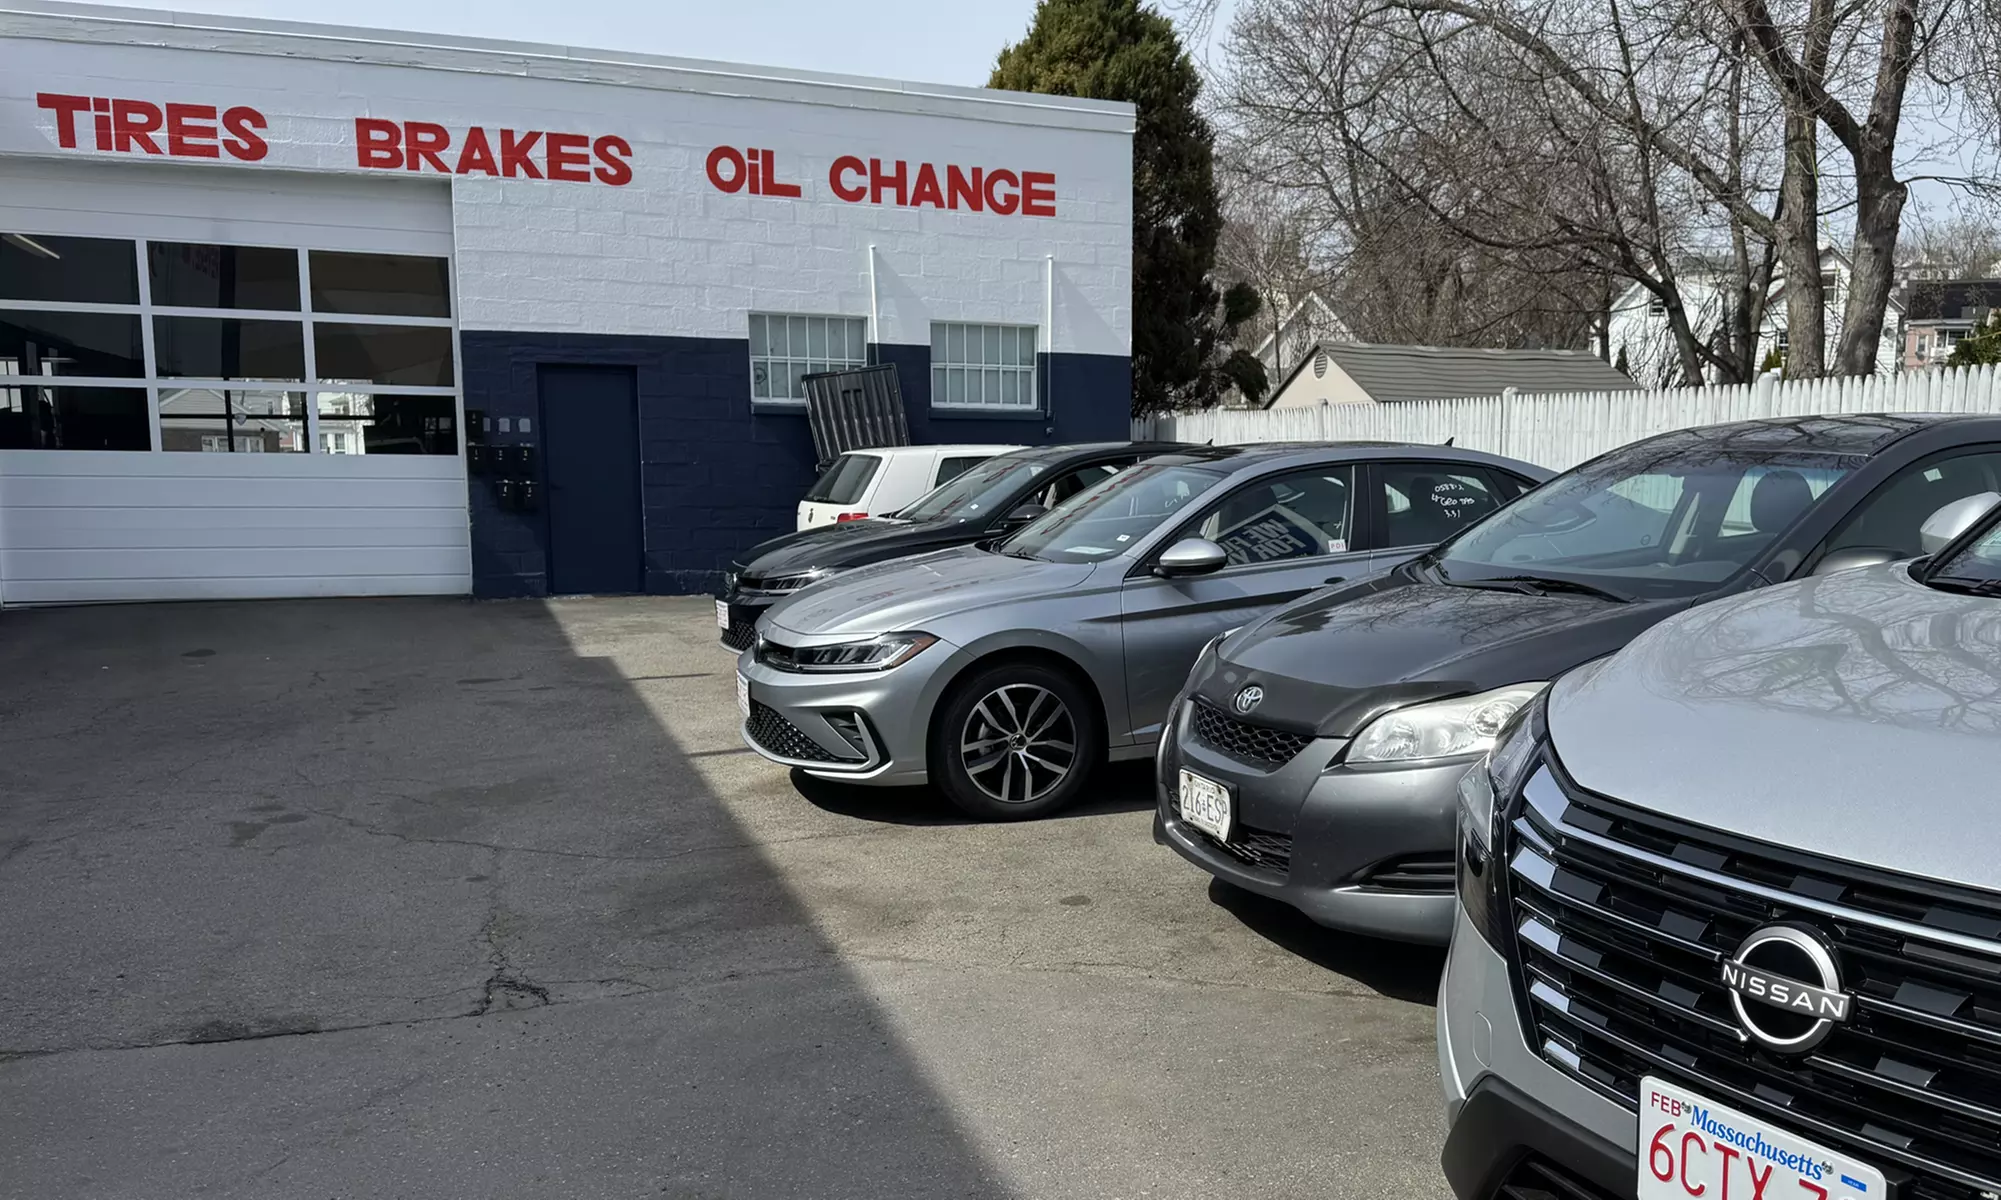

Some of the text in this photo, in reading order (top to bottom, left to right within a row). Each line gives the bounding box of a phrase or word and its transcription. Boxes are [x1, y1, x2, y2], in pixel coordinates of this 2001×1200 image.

[356, 118, 633, 186] BRAKES
[829, 155, 1056, 217] CHANGE
[1722, 964, 1844, 1018] NISSAN
[1651, 1091, 1681, 1117] FEB
[1691, 1105, 1823, 1181] Massachusetts
